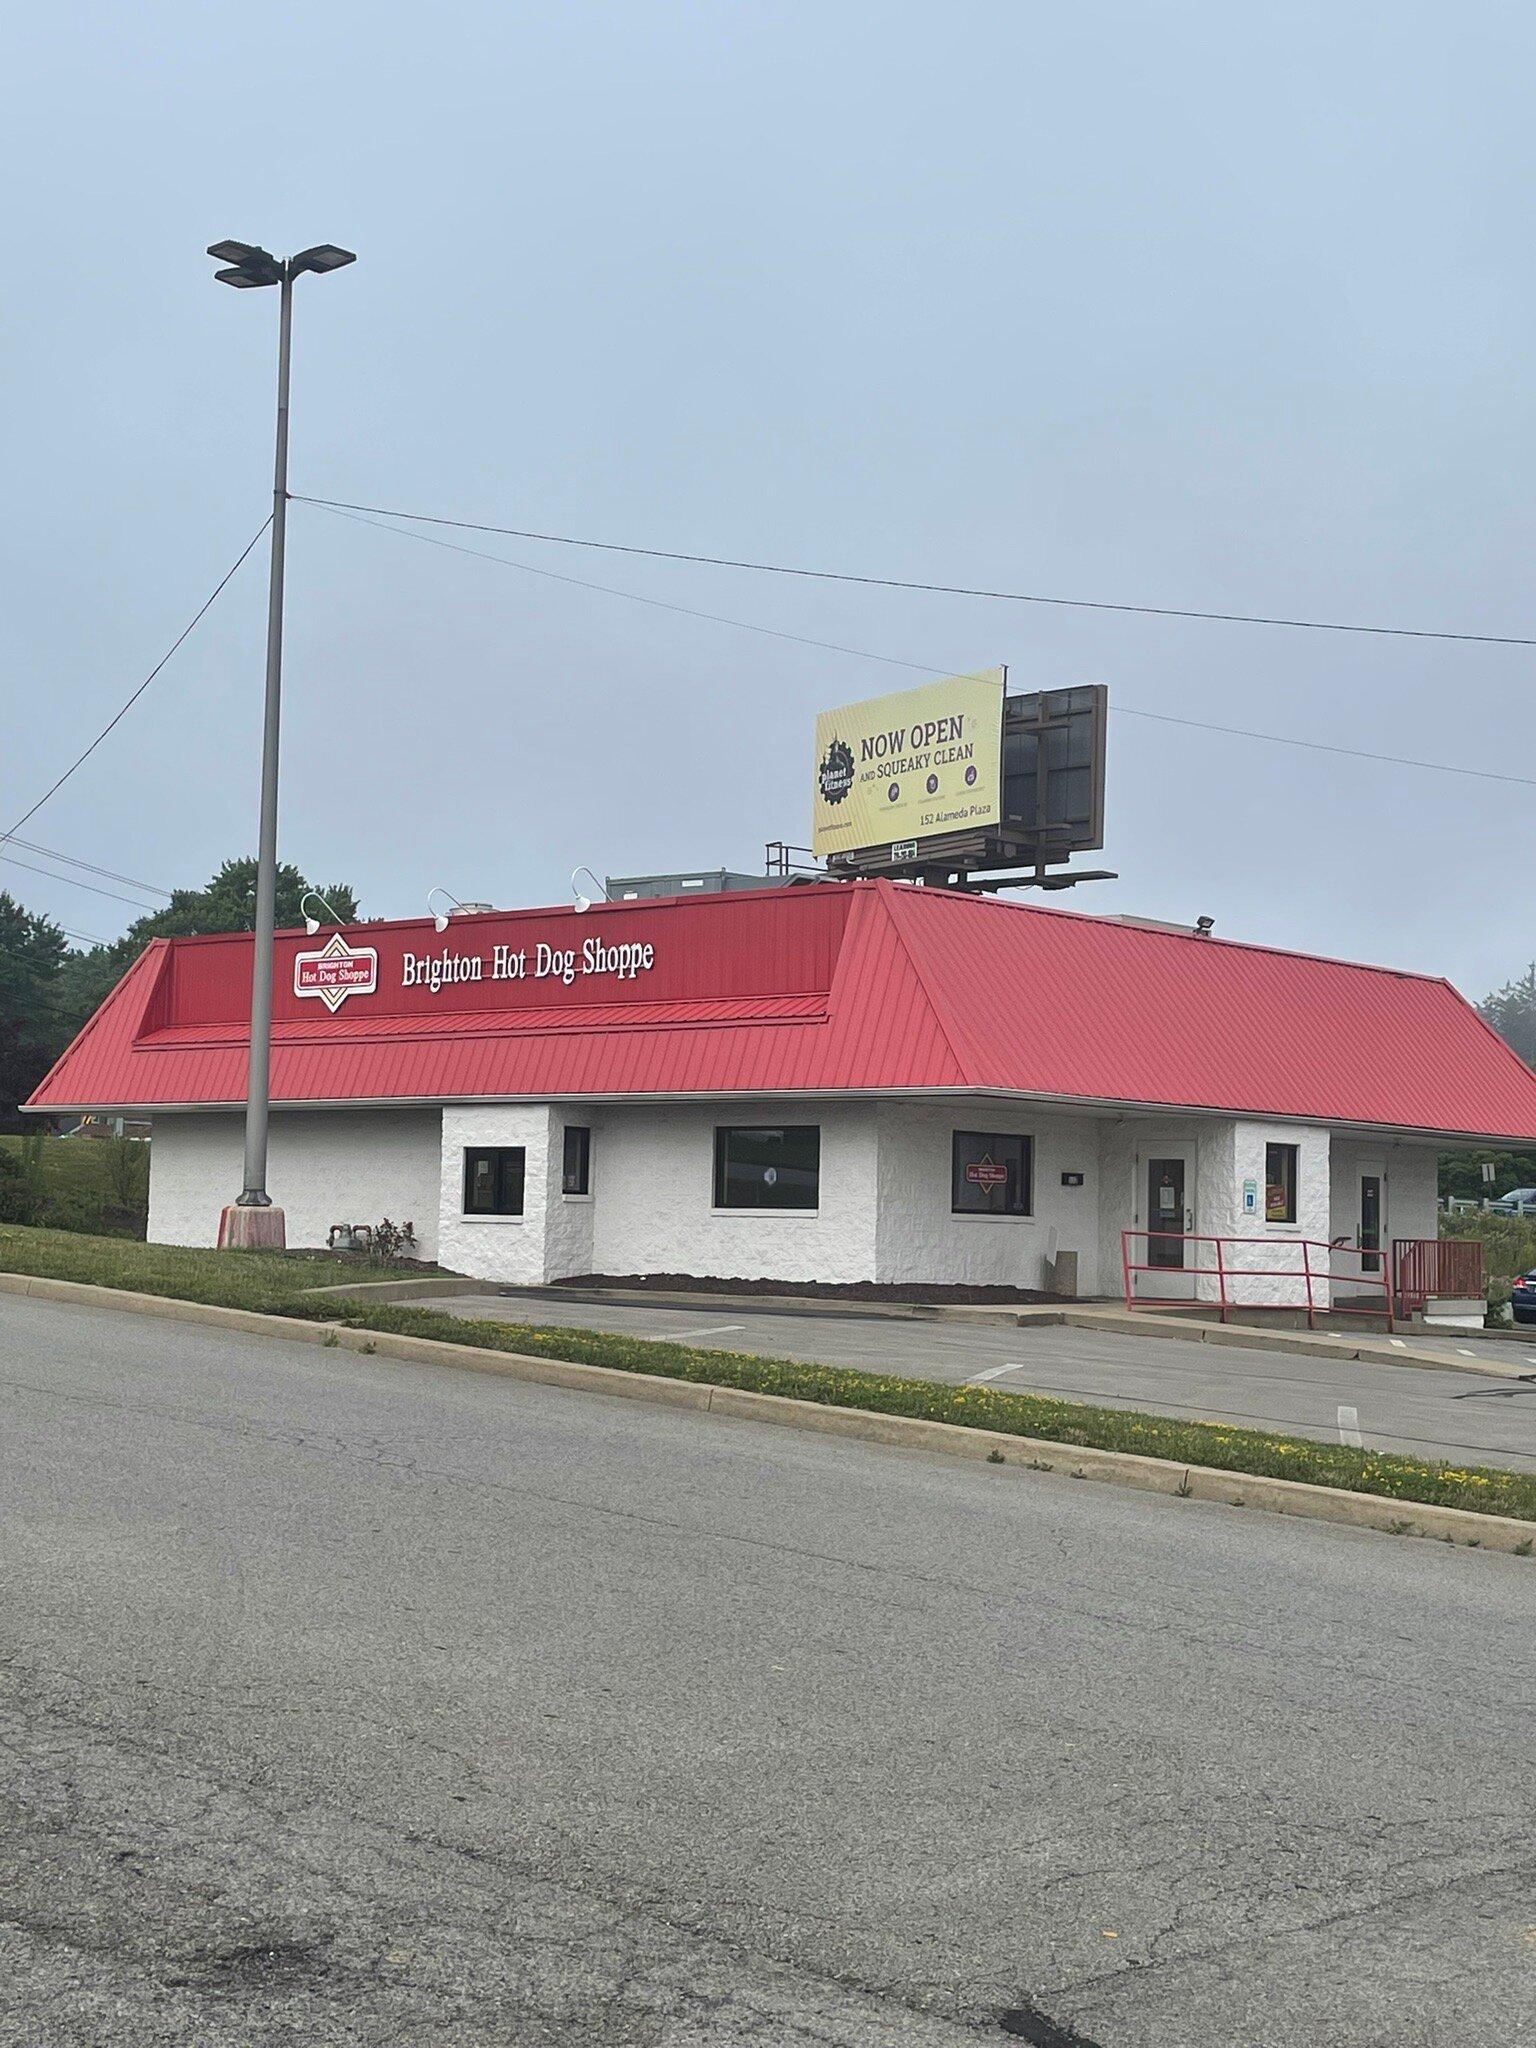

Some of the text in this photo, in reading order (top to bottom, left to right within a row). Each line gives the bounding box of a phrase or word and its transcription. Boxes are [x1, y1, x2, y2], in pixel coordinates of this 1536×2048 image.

[861, 715, 964, 762] NOW OPEN
[860, 743, 974, 782] AND SQUEAKY CLEAN
[822, 767, 847, 784] planet
[825, 778, 851, 791] fitness
[920, 805, 991, 826] 152 Alameda Plaza
[317, 961, 354, 970] BRIGHTON
[401, 937, 654, 993] Brighton Hot Dog Shoppe
[302, 969, 370, 983] Hot Dog Shoppe
